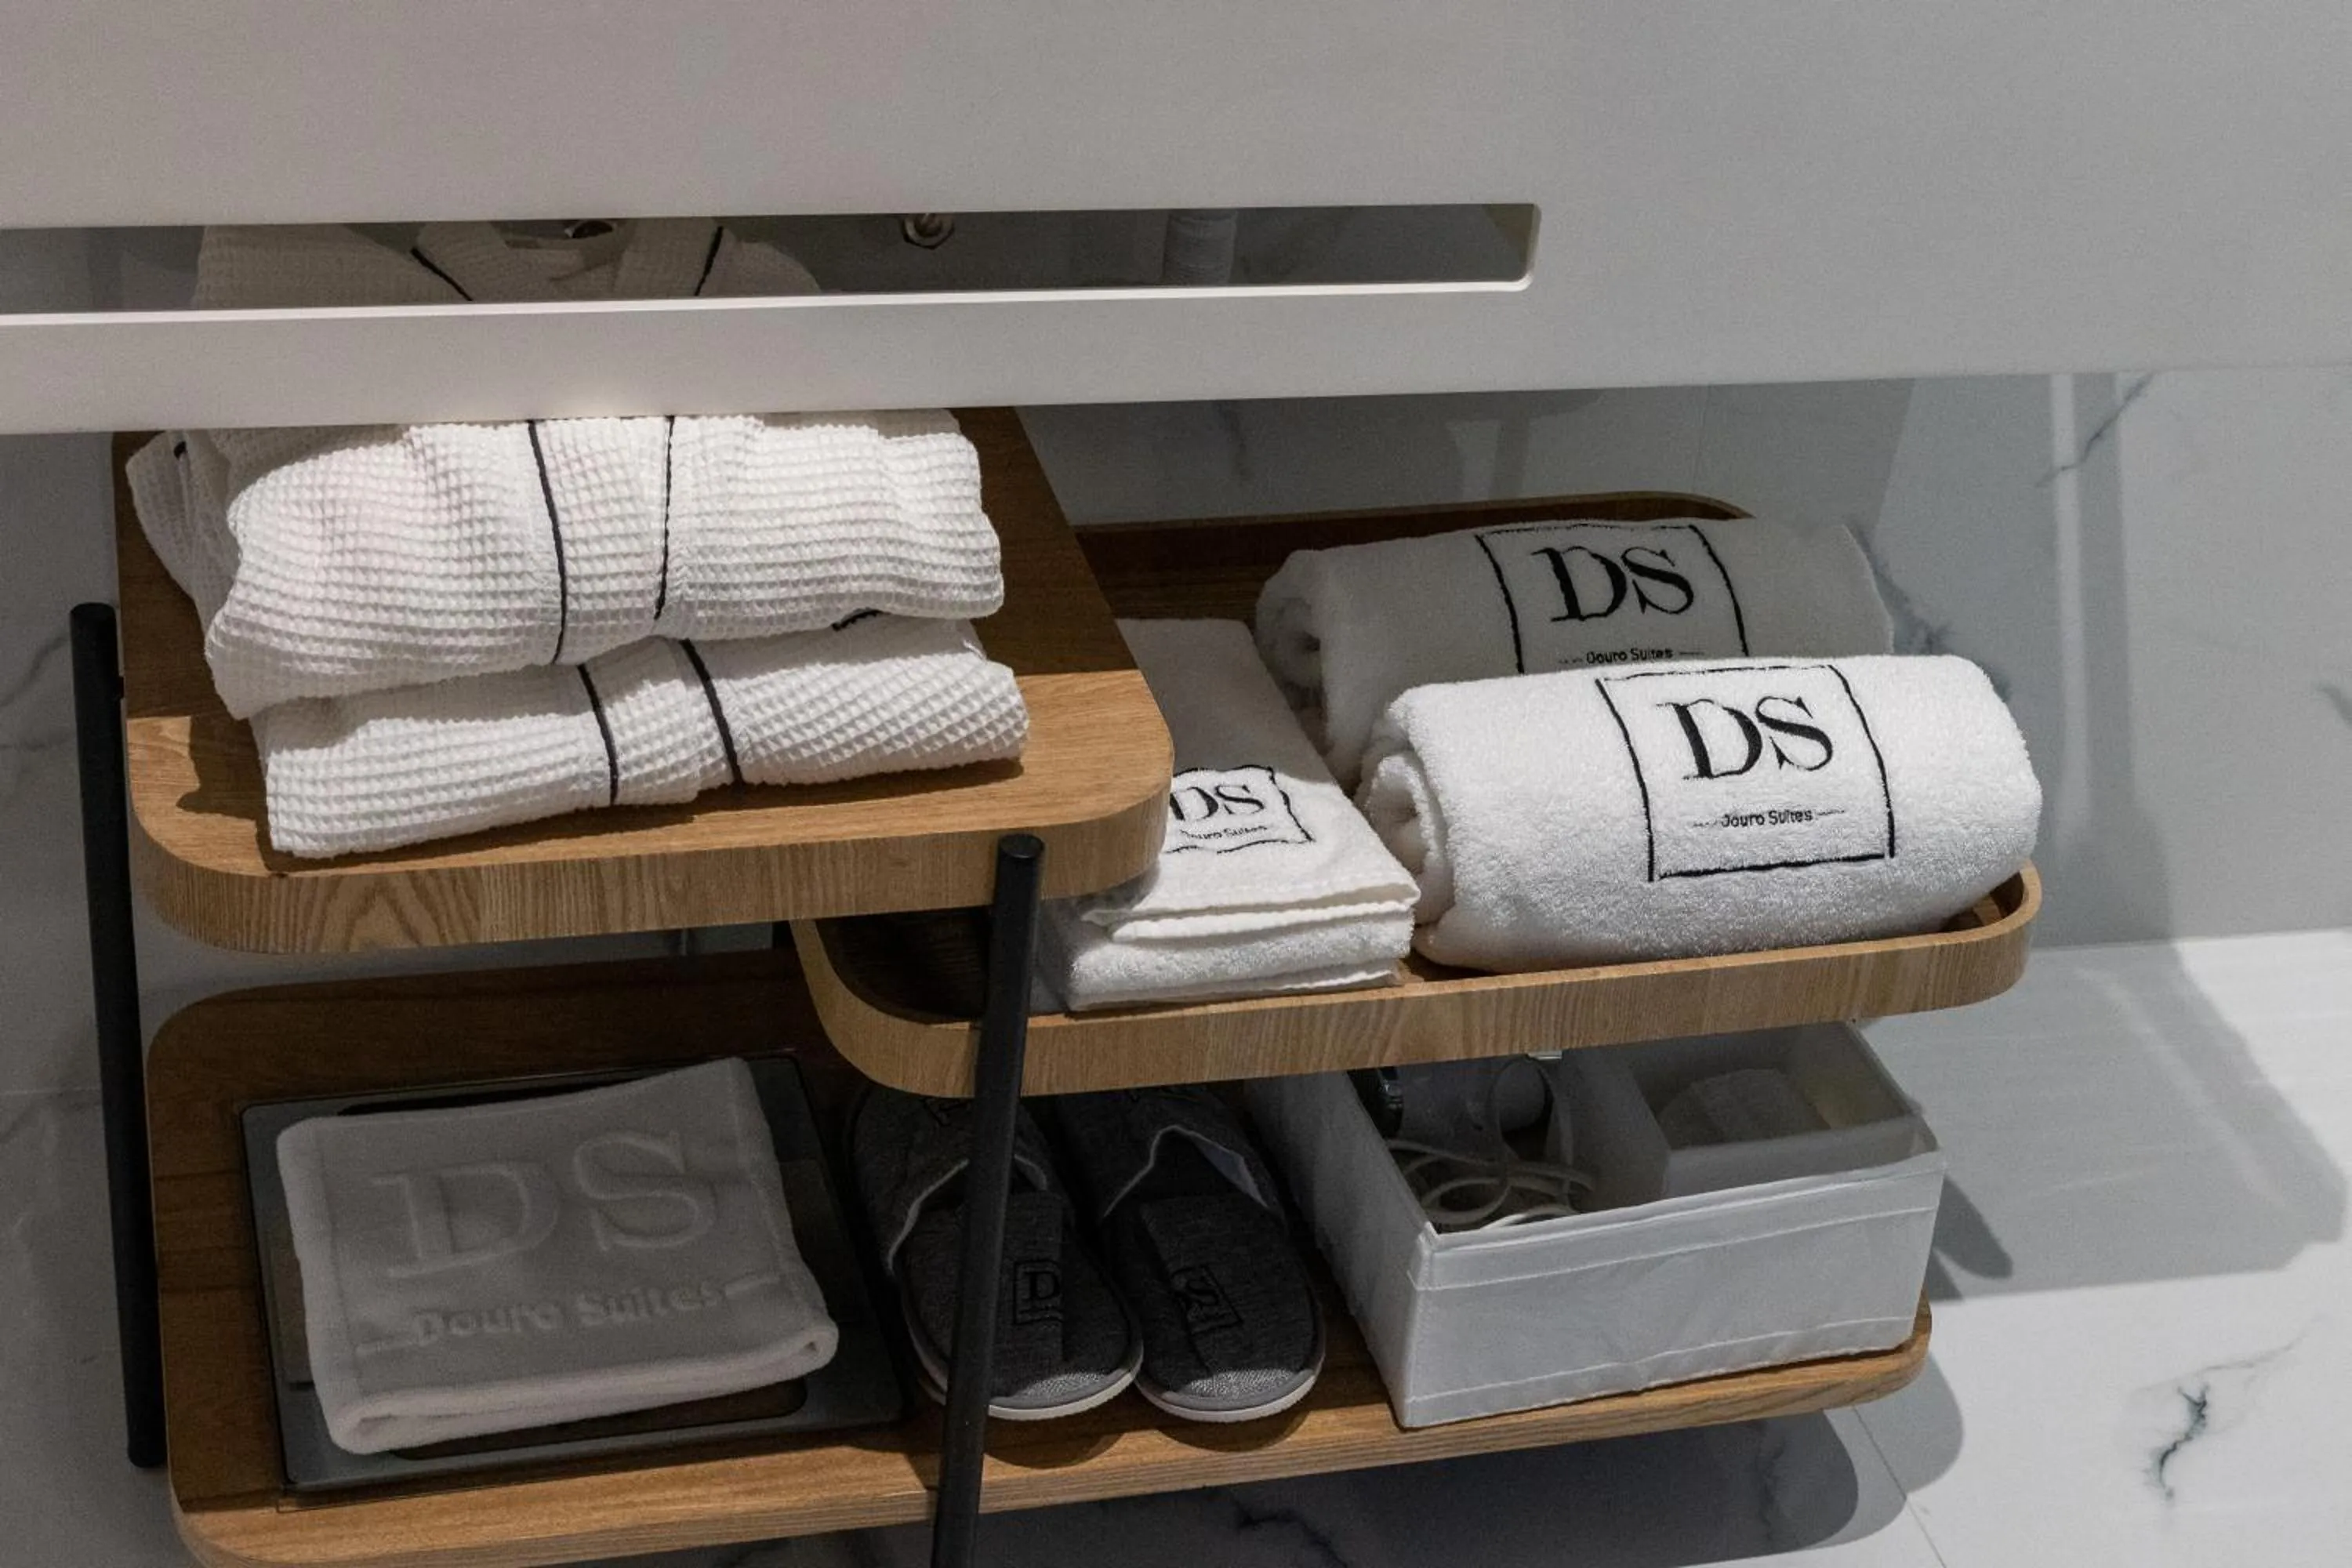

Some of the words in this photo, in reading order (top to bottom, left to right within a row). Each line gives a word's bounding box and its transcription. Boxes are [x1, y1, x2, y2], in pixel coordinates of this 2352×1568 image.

[1531, 546, 1694, 622] DS
[1586, 650, 1628, 664] Douro
[1630, 647, 1674, 662] Suites
[1656, 695, 1834, 779] DS
[1169, 784, 1265, 822] DS
[1768, 808, 1813, 826] Suites
[371, 1131, 718, 1278] DS
[1022, 1269, 1062, 1301] D
